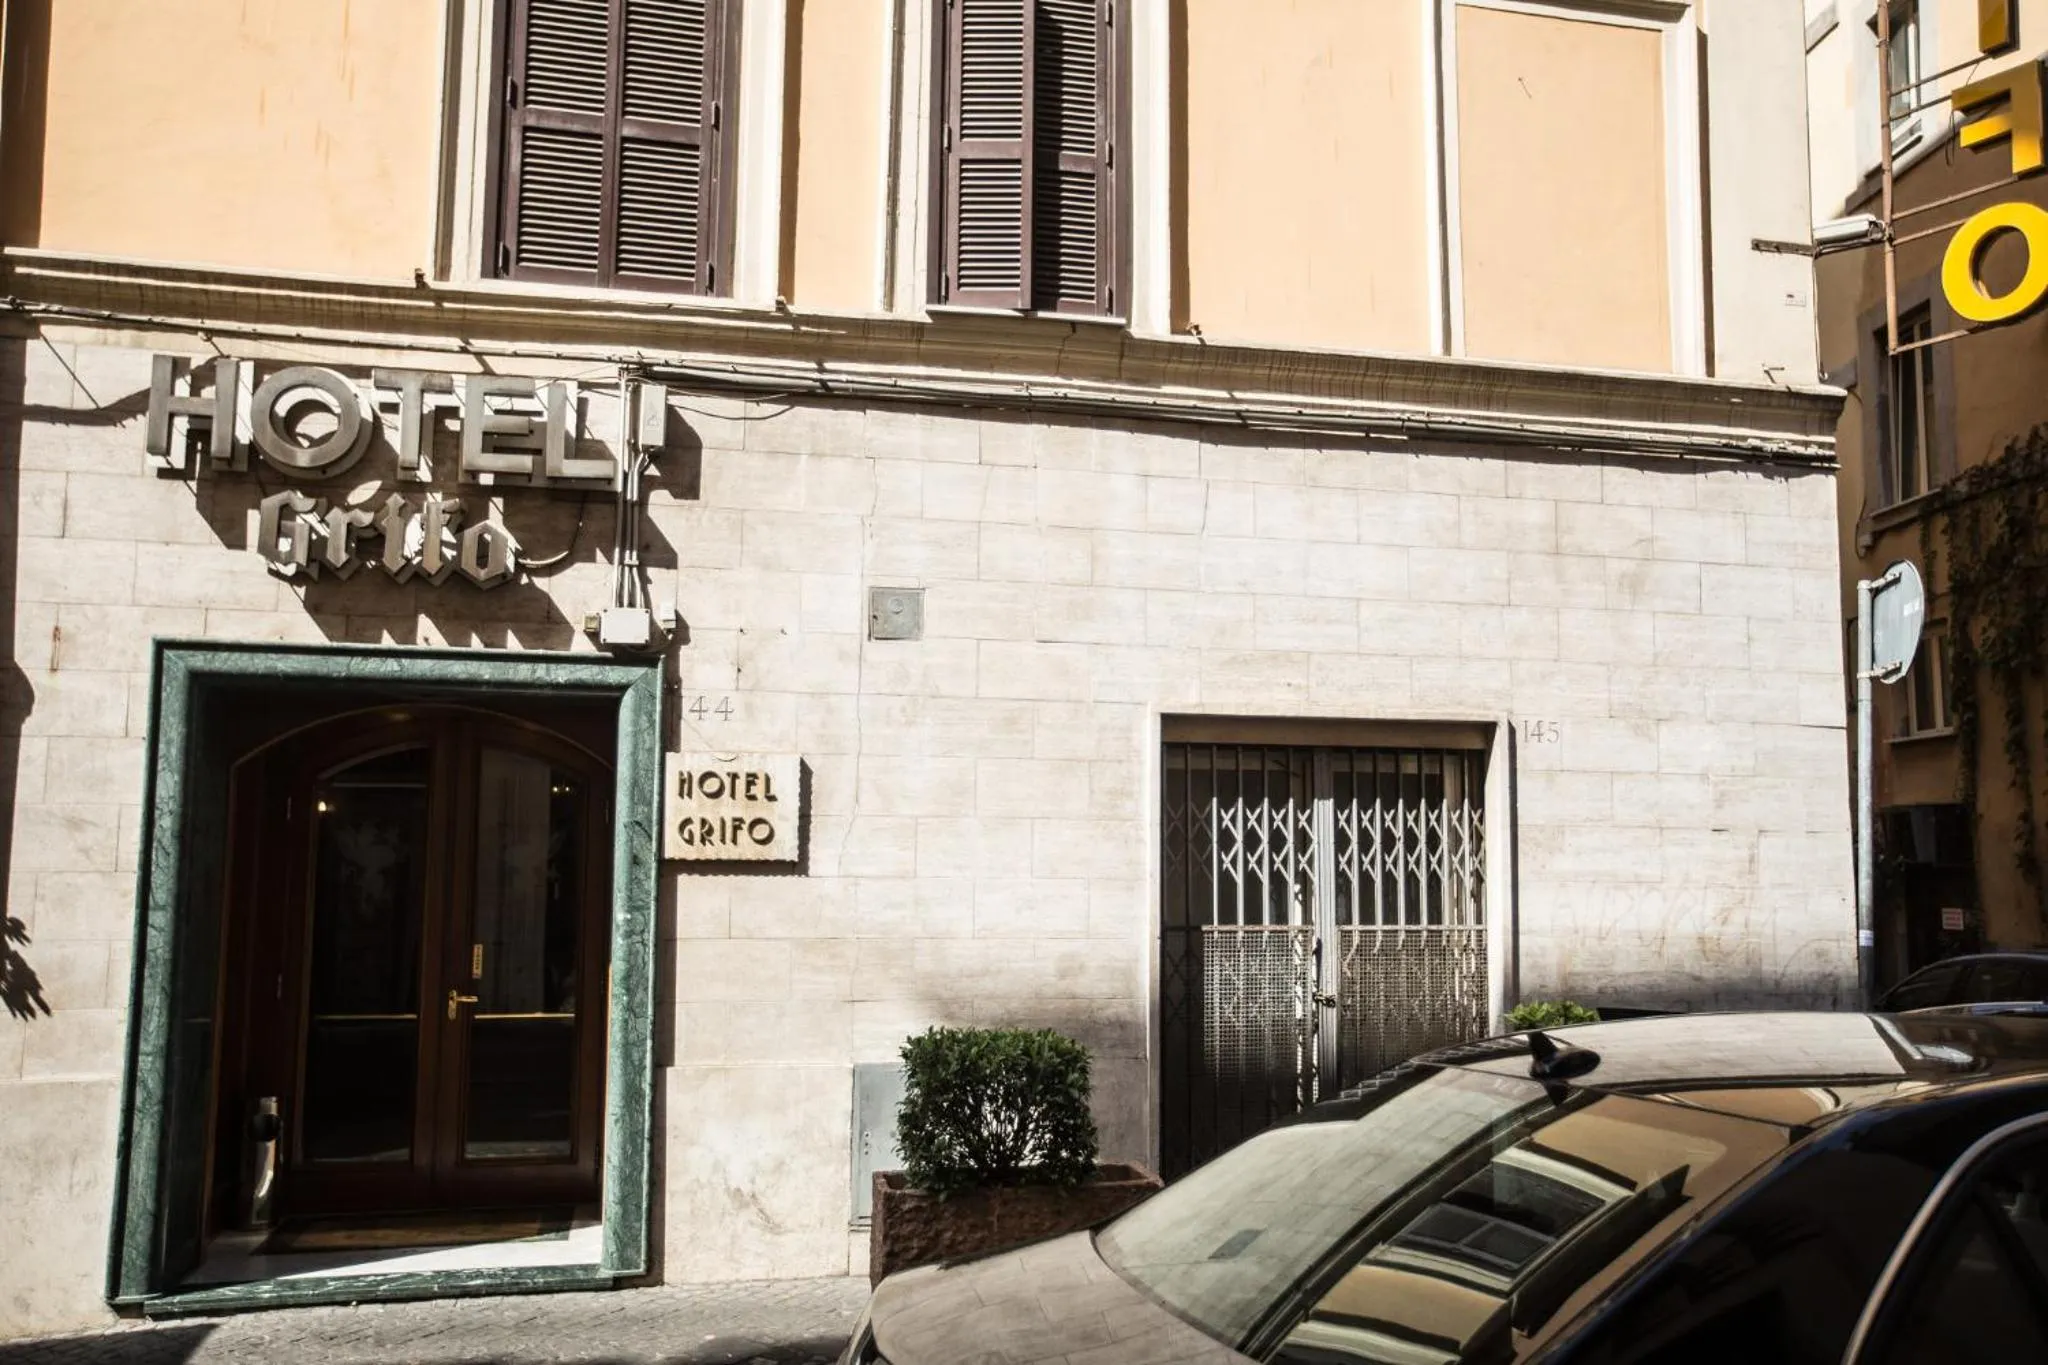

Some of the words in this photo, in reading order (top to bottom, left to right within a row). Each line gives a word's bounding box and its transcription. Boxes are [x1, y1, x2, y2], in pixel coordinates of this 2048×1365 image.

[146, 354, 618, 488] HOTEL
[257, 489, 511, 585] Grifo
[1523, 719, 1560, 744] 145
[677, 769, 778, 802] HOTEL
[677, 816, 776, 847] GRIFO
